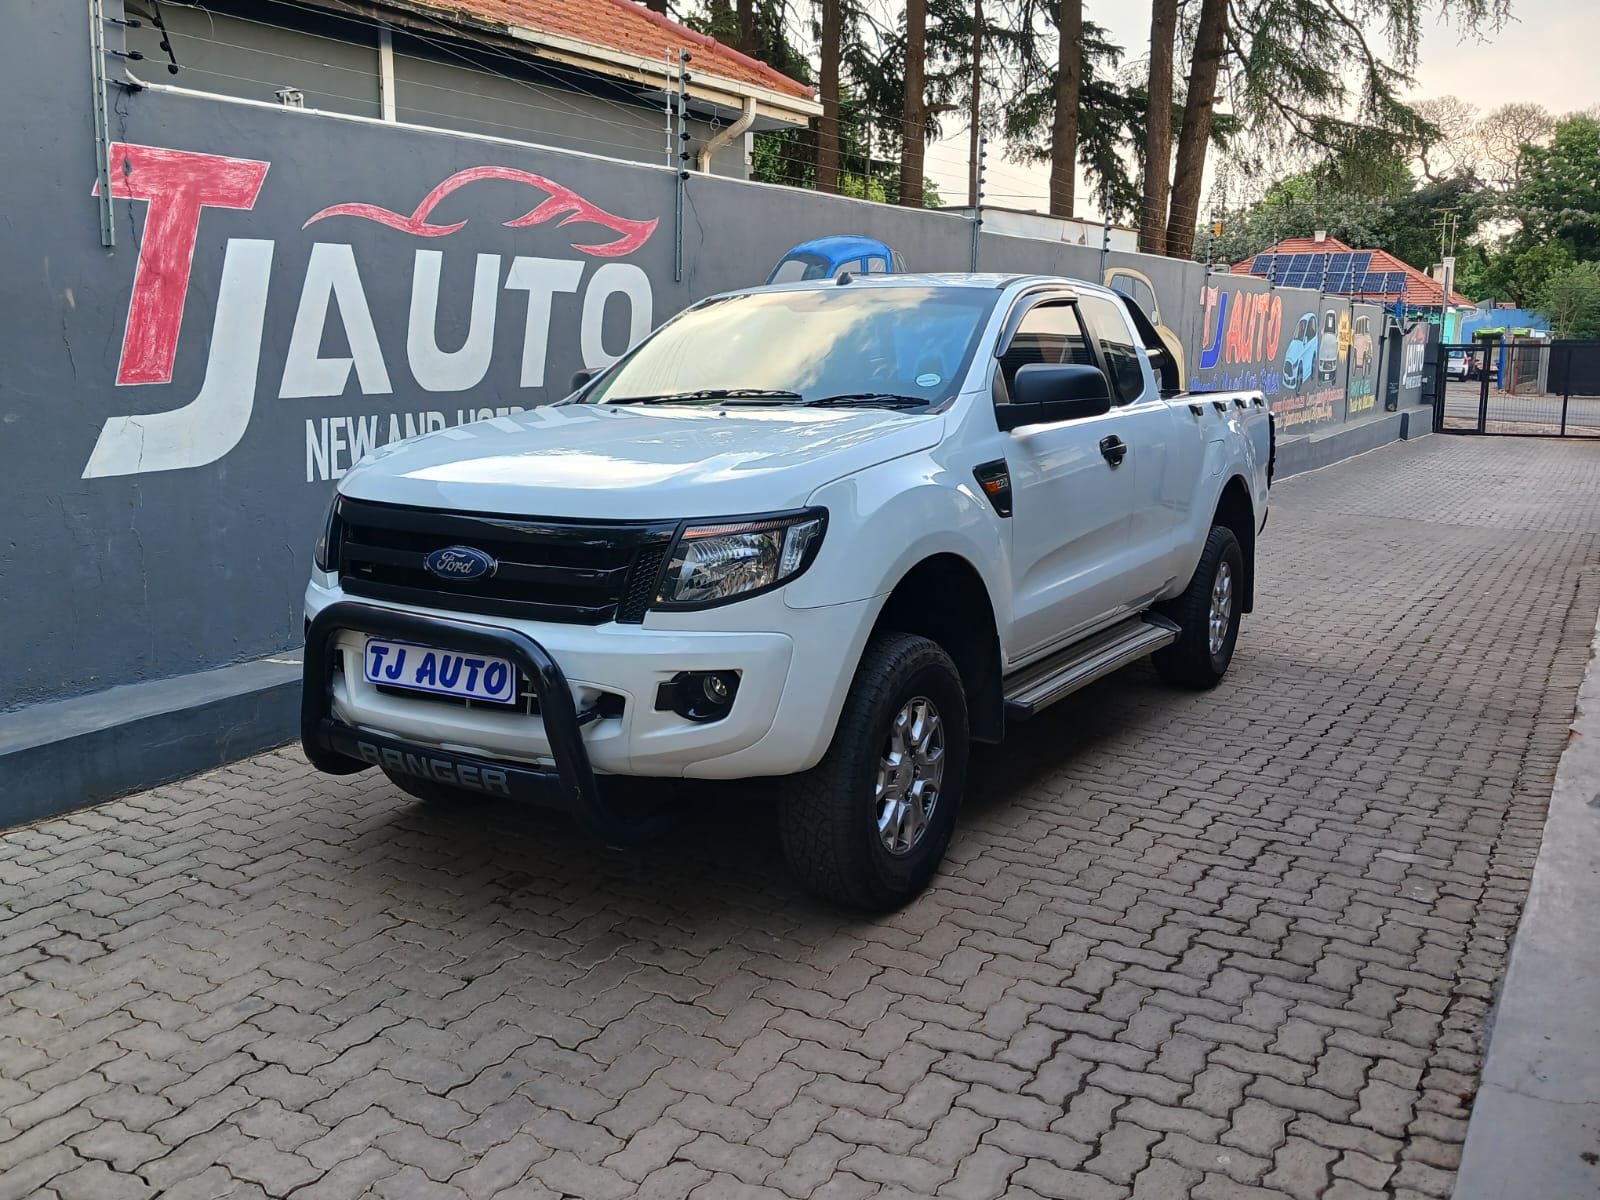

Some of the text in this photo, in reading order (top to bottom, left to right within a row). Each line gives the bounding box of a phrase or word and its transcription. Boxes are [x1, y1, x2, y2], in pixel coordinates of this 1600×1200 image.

[81, 142, 653, 479] TJ AUTO
[1199, 286, 1282, 370] TJ AUTO
[305, 414, 378, 482] NEW
[436, 551, 475, 574] Ford
[370, 645, 508, 695] TJ AUTO
[357, 740, 511, 794] RANGER
